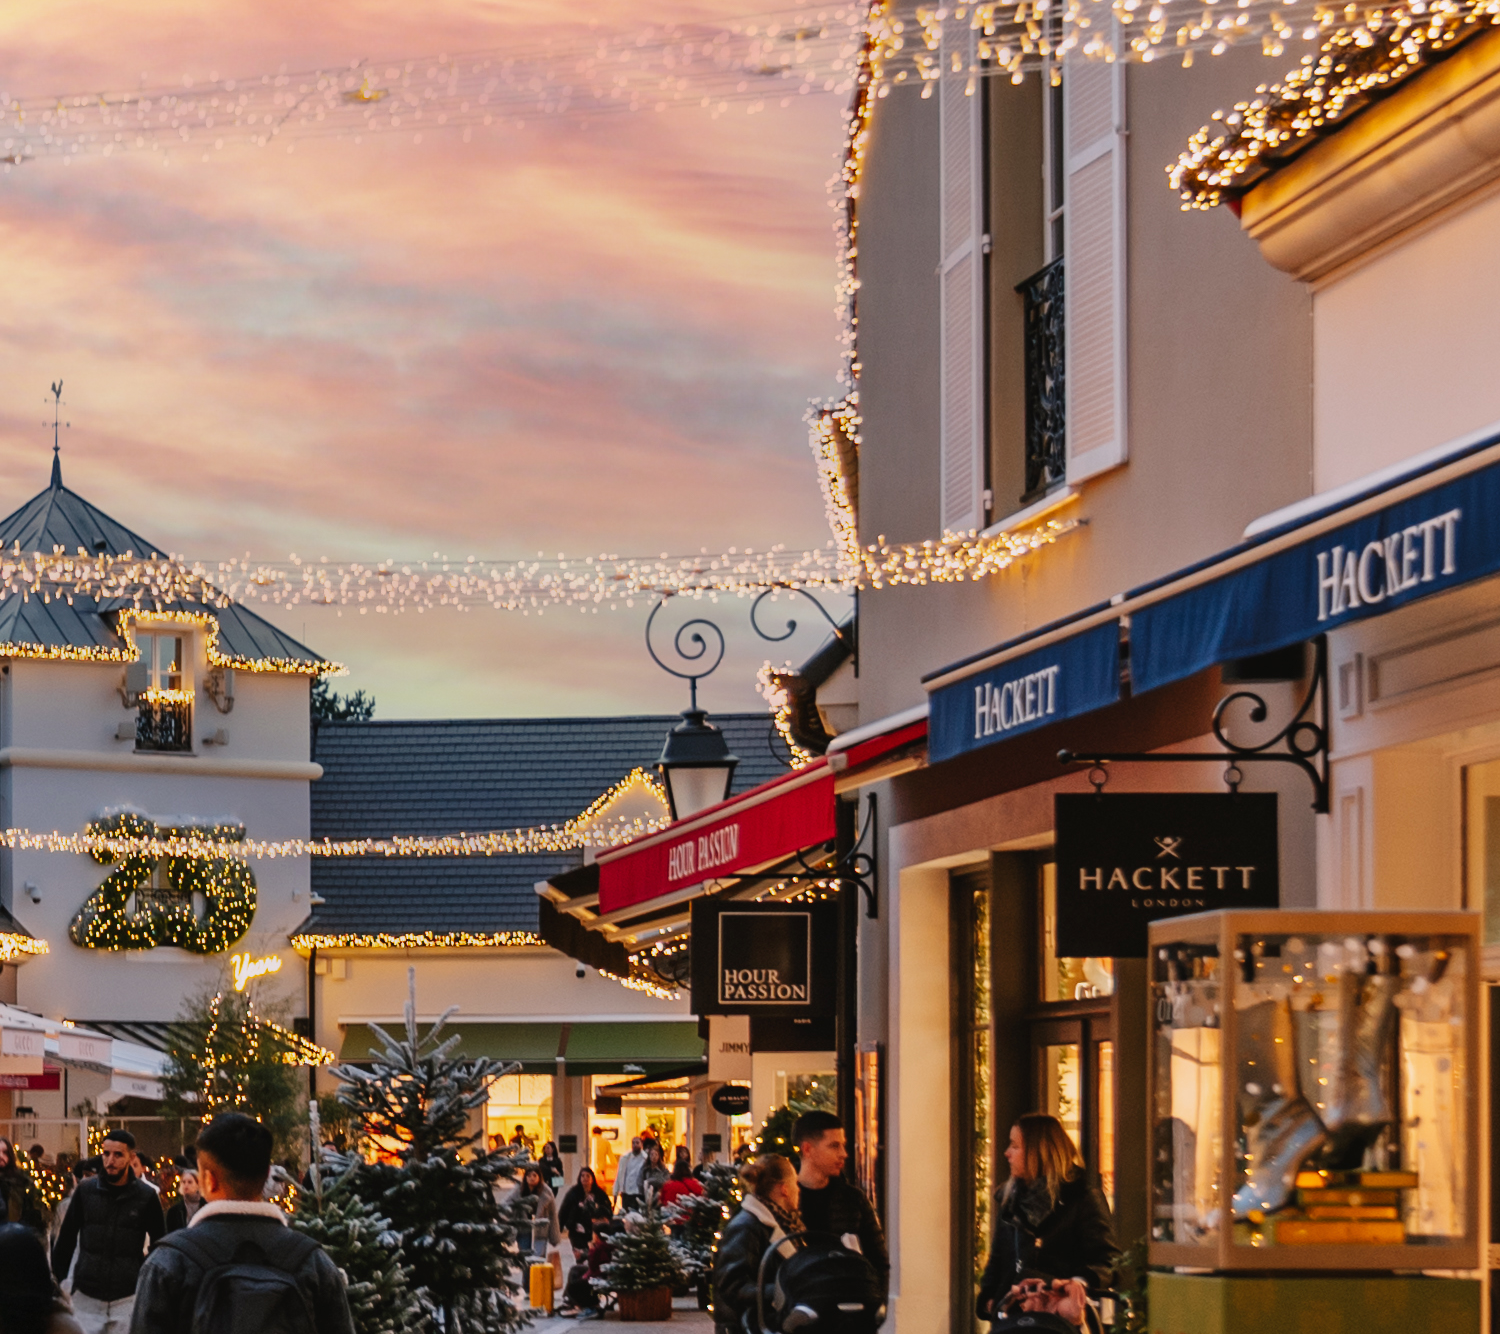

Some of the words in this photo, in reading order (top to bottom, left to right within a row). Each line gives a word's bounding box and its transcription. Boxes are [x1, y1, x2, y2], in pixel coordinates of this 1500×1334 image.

[1316, 508, 1462, 621] HACKETT
[974, 665, 1059, 739] HACKETT
[668, 840, 696, 882] HOUR
[698, 823, 739, 871] PASSION
[69, 810, 257, 955] 25
[1080, 866, 1256, 890] HACKETT
[1131, 898, 1205, 908] LONDON
[231, 953, 282, 991] Years
[724, 969, 781, 984] HOUR
[724, 984, 806, 999] PASSION
[14, 1035, 34, 1051] GUCCI
[719, 1042, 749, 1053] JIMMY
